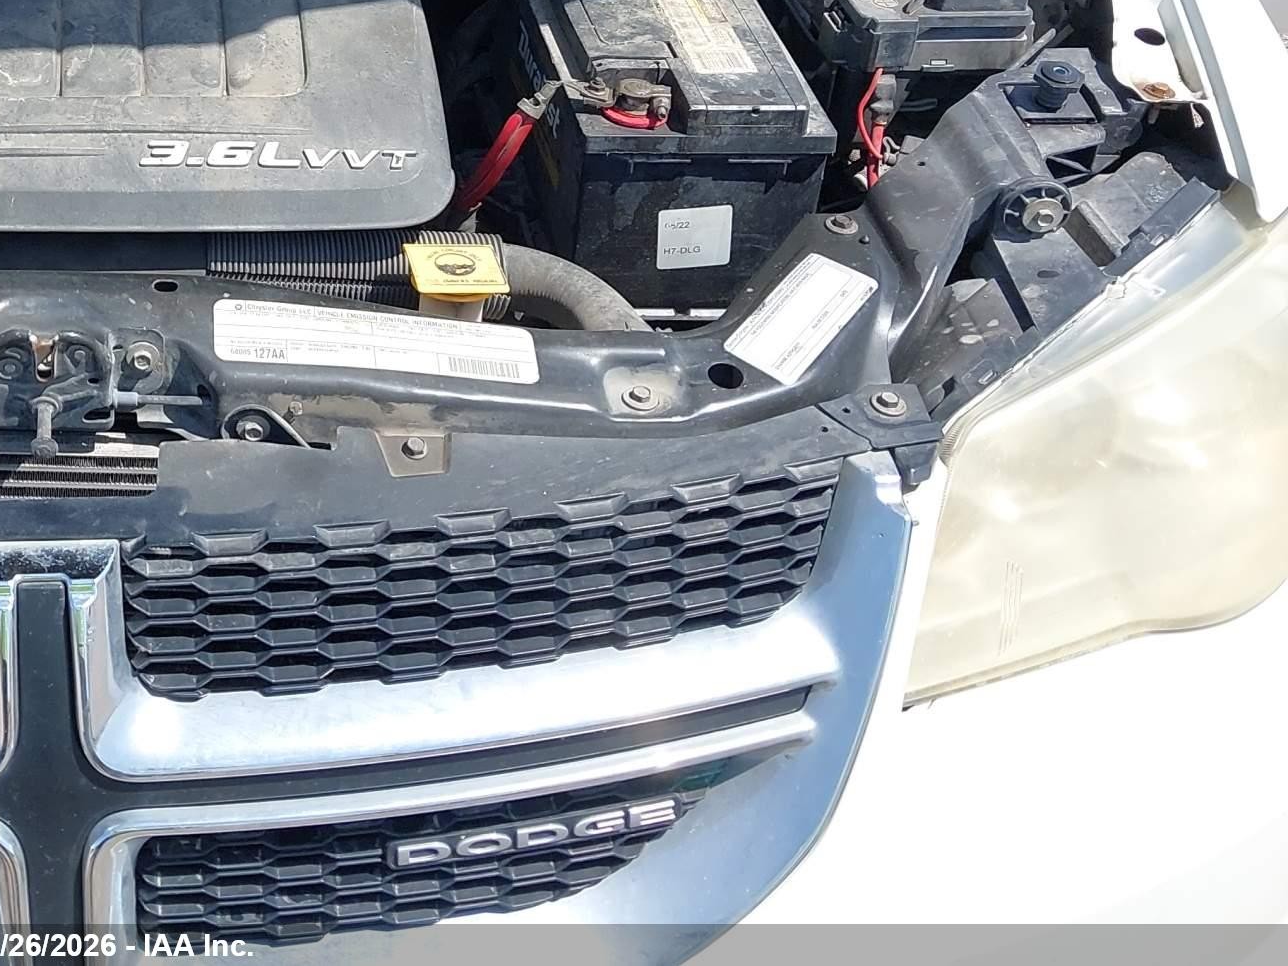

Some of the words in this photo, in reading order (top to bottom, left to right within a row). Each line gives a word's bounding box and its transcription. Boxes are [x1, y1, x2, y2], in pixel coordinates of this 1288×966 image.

[302, 148, 418, 171] VVT
[663, 245, 701, 255] H7-DLG
[253, 347, 286, 360] 127AA
[397, 798, 677, 868] DODGE
